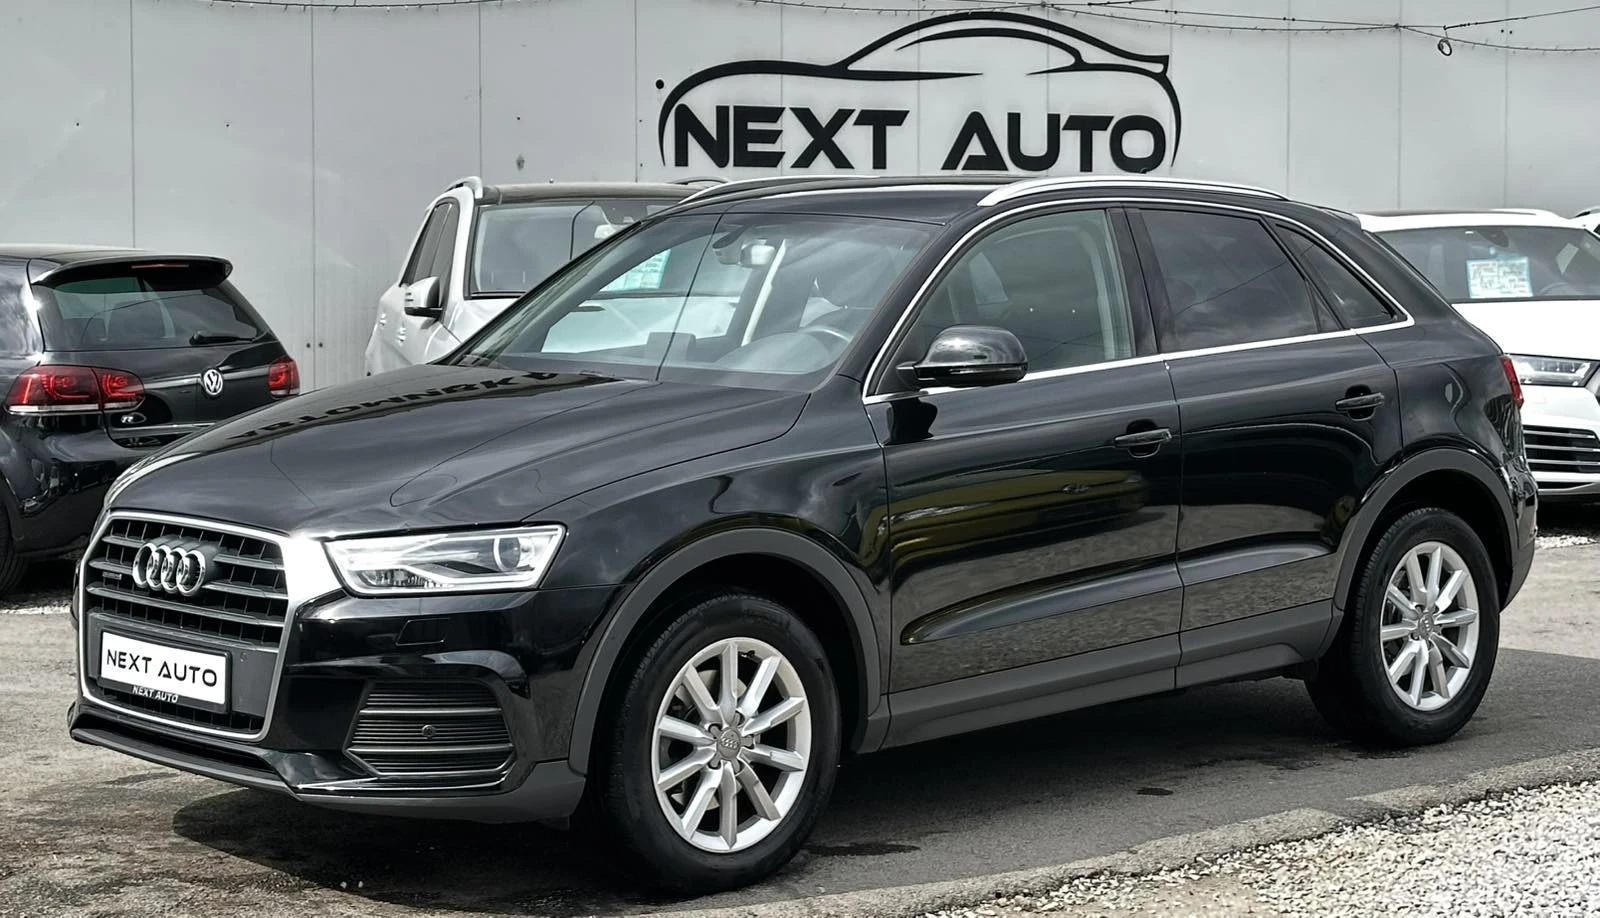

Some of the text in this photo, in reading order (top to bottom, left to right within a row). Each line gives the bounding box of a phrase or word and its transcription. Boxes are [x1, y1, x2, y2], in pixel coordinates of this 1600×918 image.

[674, 103, 1166, 172] NEXT AUTO
[107, 649, 217, 687] NEXT AUTO
[132, 686, 179, 703] NEXT AUTO
